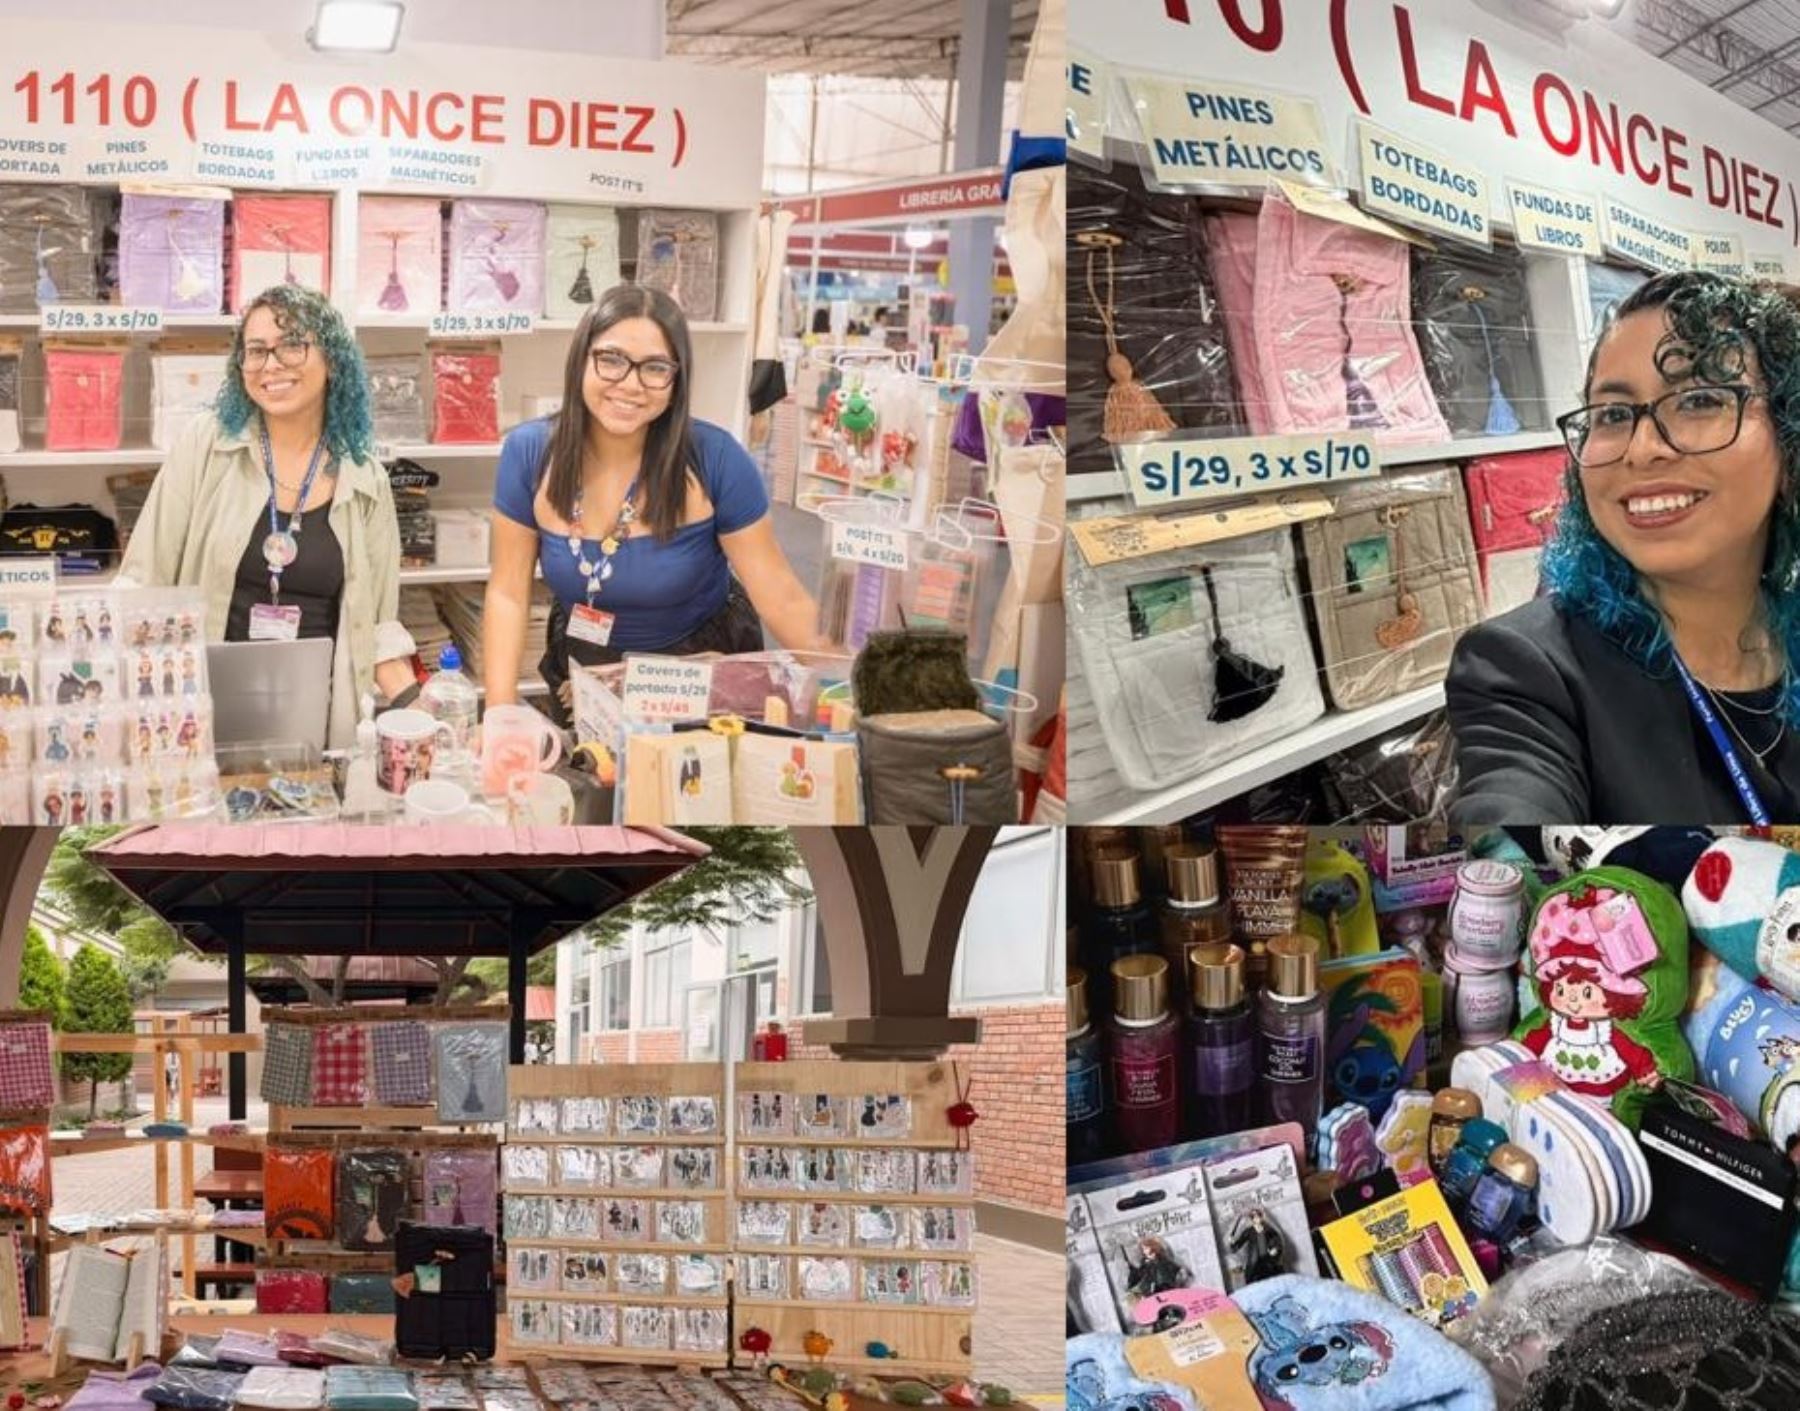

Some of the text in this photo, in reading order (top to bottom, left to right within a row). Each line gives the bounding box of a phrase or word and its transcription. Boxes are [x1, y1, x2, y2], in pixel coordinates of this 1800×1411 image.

[1066, 63, 1092, 95] E
[14, 70, 688, 168] 1110 ( LA ONCE DIEZ )
[1185, 91, 1274, 126] PINES
[1393, 4, 1518, 138] LA
[1533, 72, 1693, 198] ONCE
[1702, 144, 1784, 229] DIEZ
[49, 142, 67, 155] DE
[106, 140, 148, 154] PINES
[201, 142, 275, 162] TOTEBAGS
[296, 148, 350, 163] FUNDAS
[389, 146, 482, 168] SEPARADORES
[1153, 134, 1325, 174] METÁLICOS
[87, 159, 169, 176] METÁLICOS
[198, 161, 276, 181] BORDADAS
[390, 166, 477, 186] MAGNÉTICOS
[1371, 138, 1478, 198] TOTEBAGS
[589, 172, 620, 190] POST
[900, 186, 964, 209] LIBRERÍA
[1371, 175, 1484, 233] BORDADAS
[1512, 189, 1594, 223] FUNDAS DE
[1535, 224, 1584, 249] LIBROS
[1609, 206, 1690, 251] SEPARADORES
[46, 310, 159, 329] S/29, 3 x S/70
[474, 316, 486, 330] 3
[486, 319, 496, 330] x
[498, 315, 531, 332] S/70
[1140, 440, 1371, 496] S/29, 3 x S/70
[637, 664, 701, 678] Covers de
[626, 682, 678, 695] portada
[1664, 1126, 1702, 1150] TOMMY
[1715, 1151, 1763, 1180] HILFIGER
